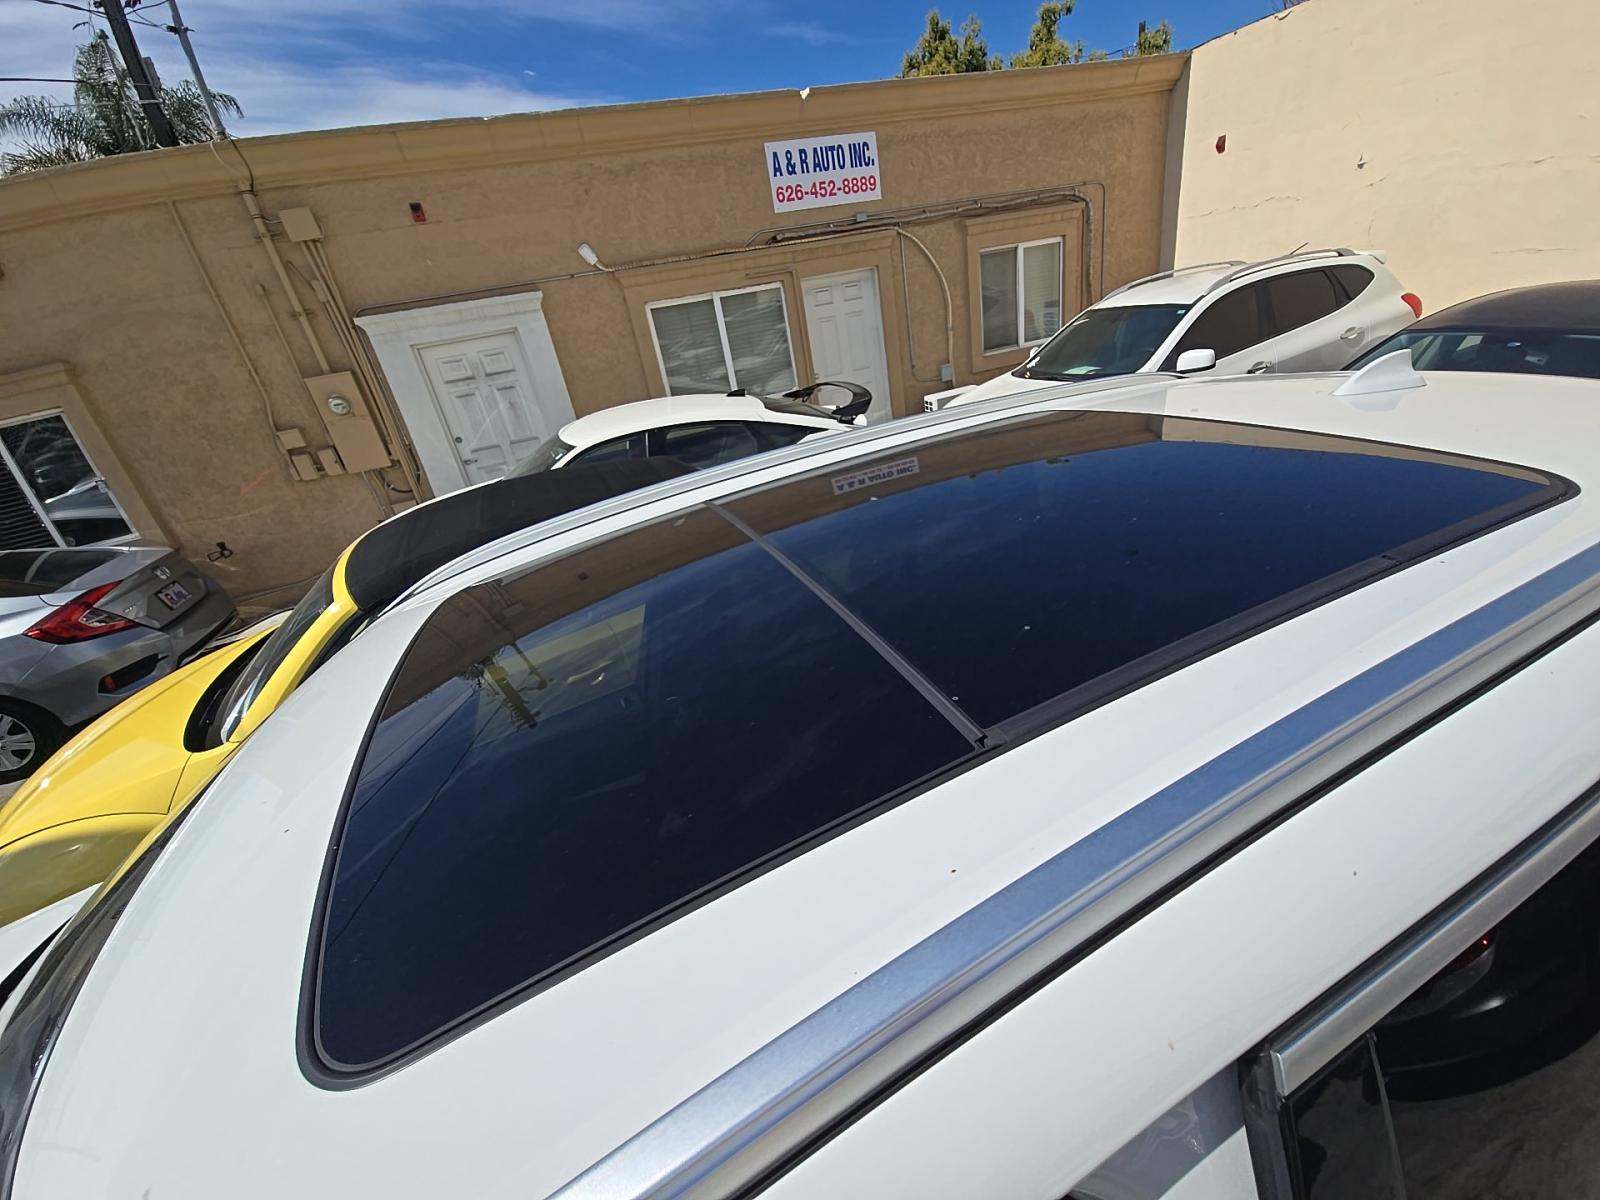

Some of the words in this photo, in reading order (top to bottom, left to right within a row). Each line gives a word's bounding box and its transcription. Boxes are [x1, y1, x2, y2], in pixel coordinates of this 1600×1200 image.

[772, 151, 783, 177] A
[785, 149, 797, 176] &
[798, 148, 810, 174] R
[812, 143, 846, 173] AUTO
[849, 141, 875, 168] INC.
[776, 175, 877, 203] 626-452-8889
